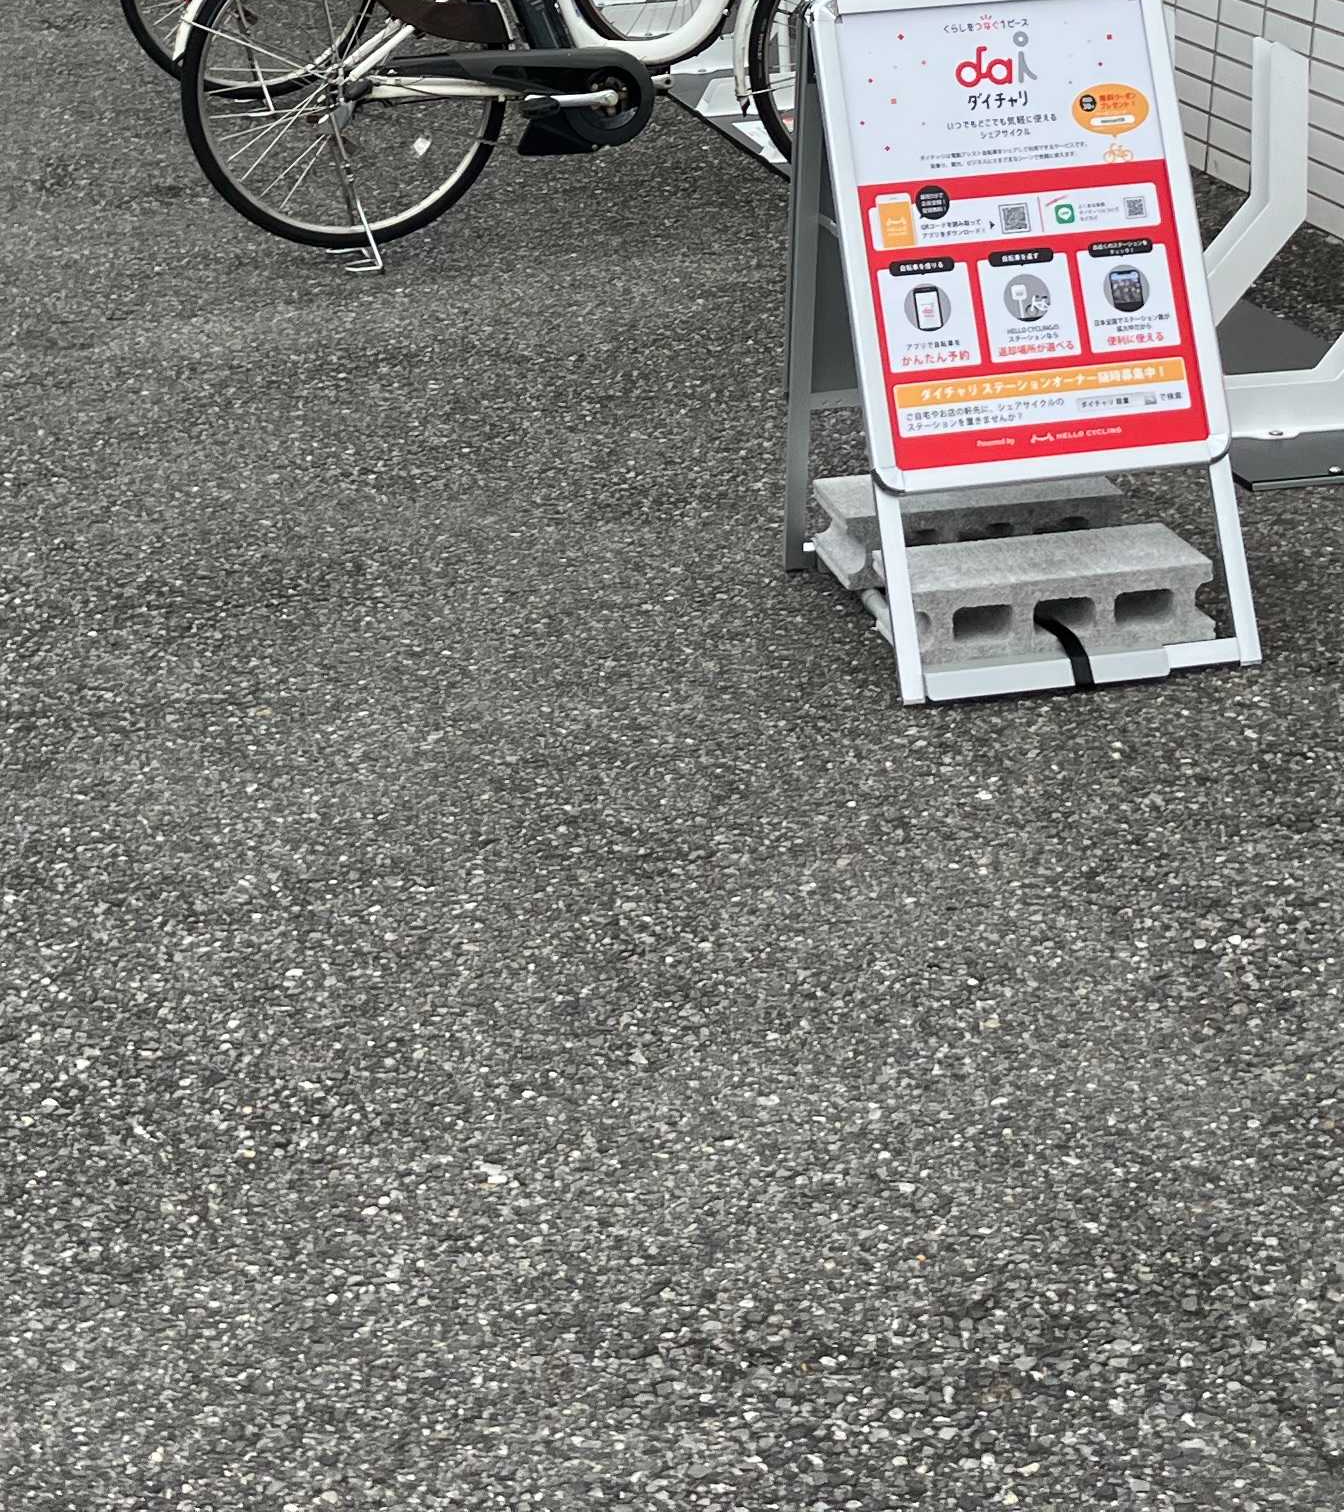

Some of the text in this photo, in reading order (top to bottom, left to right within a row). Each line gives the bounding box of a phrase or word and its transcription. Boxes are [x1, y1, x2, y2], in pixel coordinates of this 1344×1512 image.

[967, 90, 1029, 111] ダイチャリ
[902, 350, 970, 366] かんたん予約
